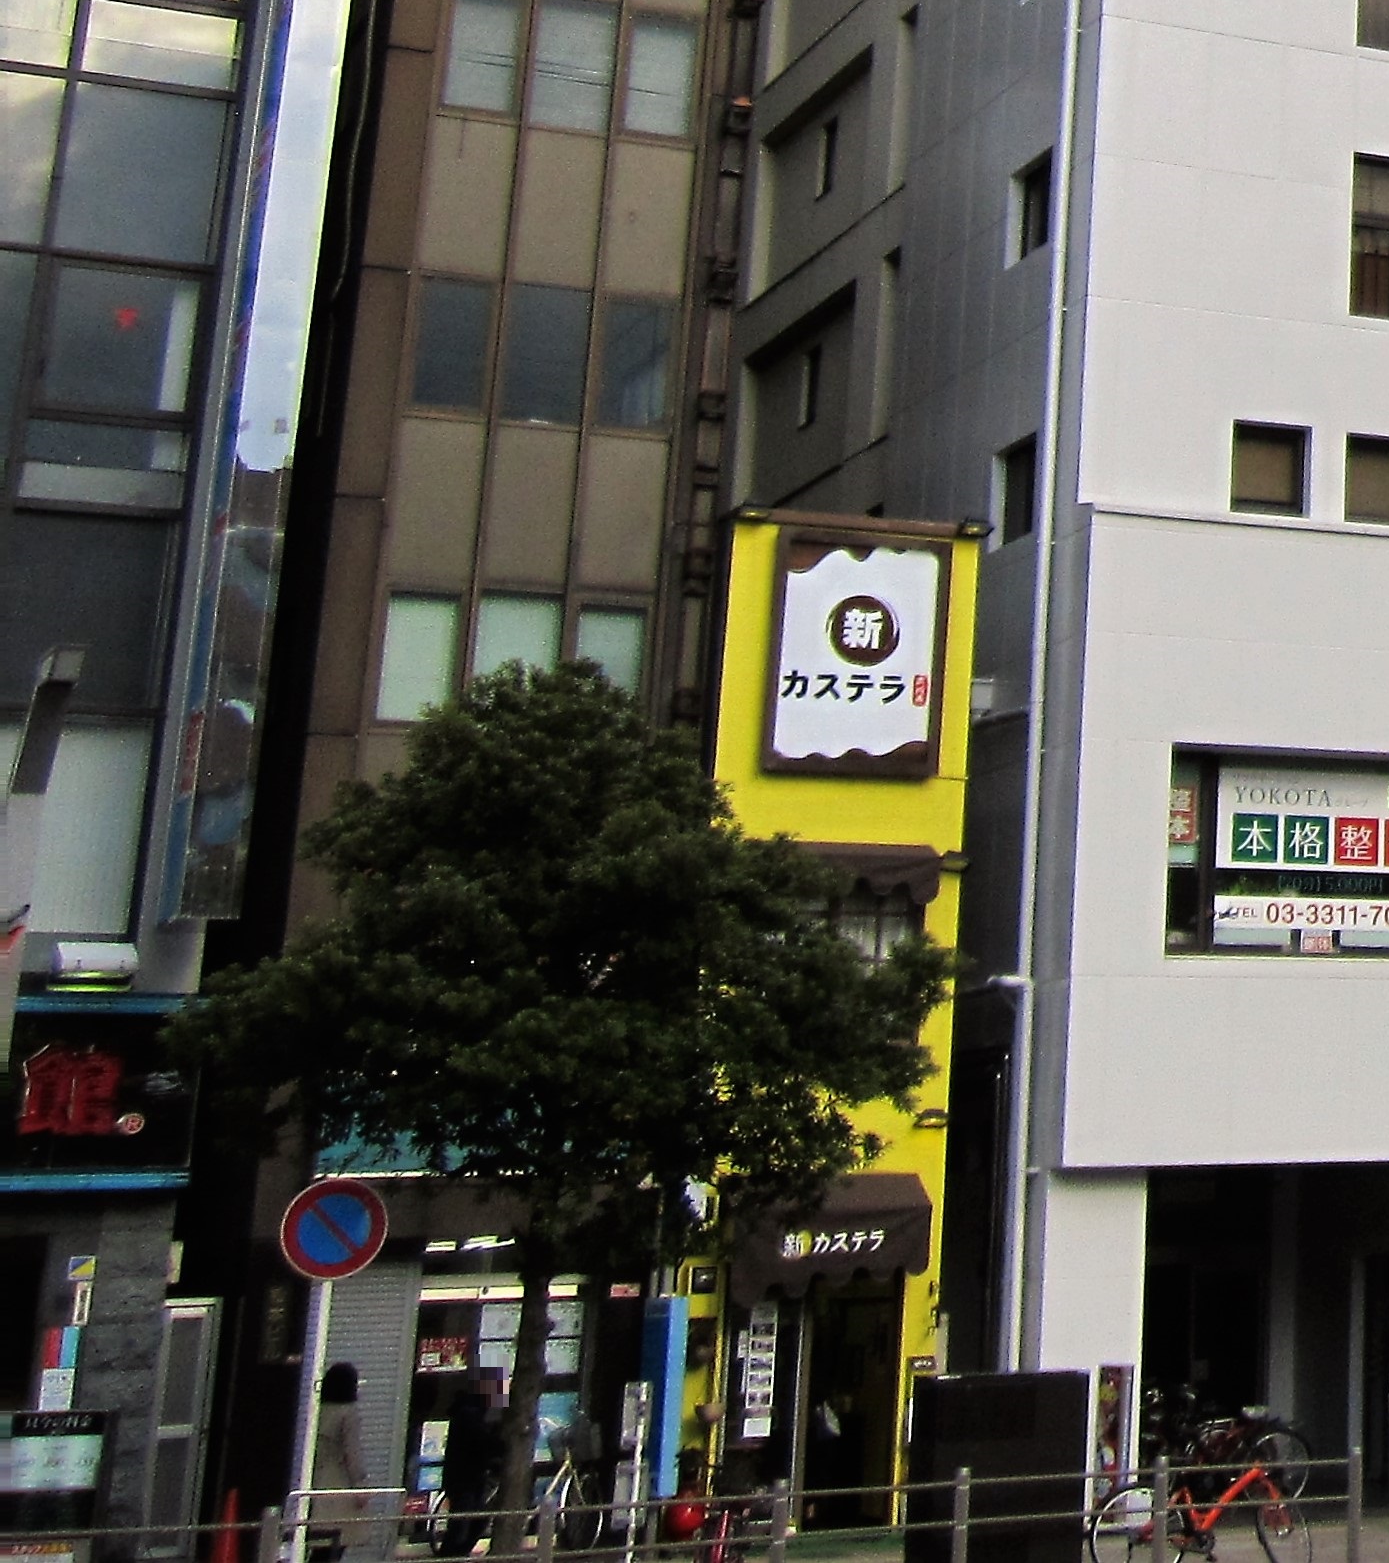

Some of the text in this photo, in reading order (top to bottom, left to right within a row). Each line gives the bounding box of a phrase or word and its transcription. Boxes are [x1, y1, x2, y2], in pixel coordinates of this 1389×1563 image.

[843, 607, 882, 650] 新
[780, 669, 907, 705] カステラ
[1235, 785, 1333, 808] YOKOTA
[1236, 907, 1259, 918] TEL
